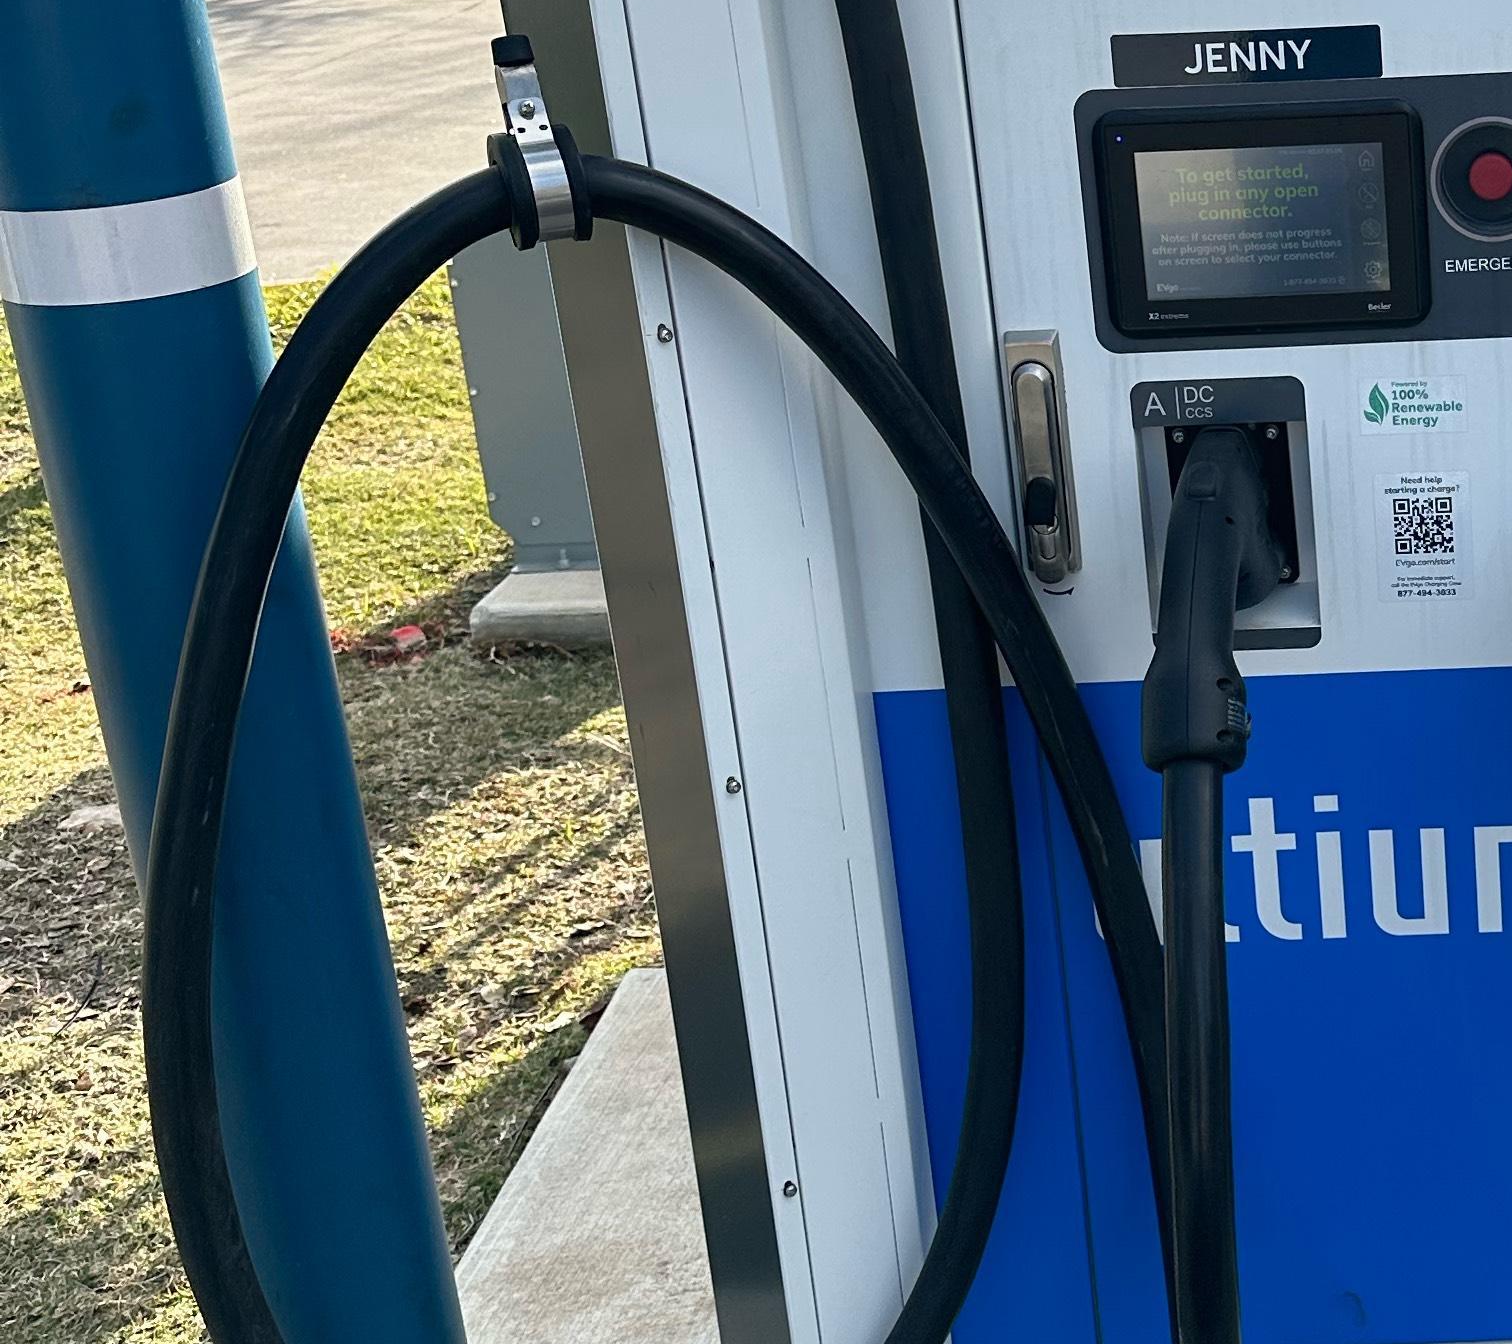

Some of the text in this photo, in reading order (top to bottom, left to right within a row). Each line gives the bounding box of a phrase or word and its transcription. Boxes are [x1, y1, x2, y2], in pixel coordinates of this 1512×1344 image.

[1184, 39, 1312, 74] JENNY
[1175, 163, 1309, 186] To get started,
[1168, 185, 1319, 206] plug in any open
[1199, 205, 1293, 221] connector.
[1201, 233, 1236, 242] screen
[1238, 231, 1263, 240] does
[1265, 230, 1284, 239] not
[1286, 229, 1333, 240] progress
[1301, 238, 1342, 248] buttons
[1144, 385, 1215, 417] A DC
[1391, 389, 1429, 400] 100%
[1185, 407, 1214, 419] CCS
[1391, 401, 1463, 413] Renewable
[1392, 415, 1439, 428] Energy
